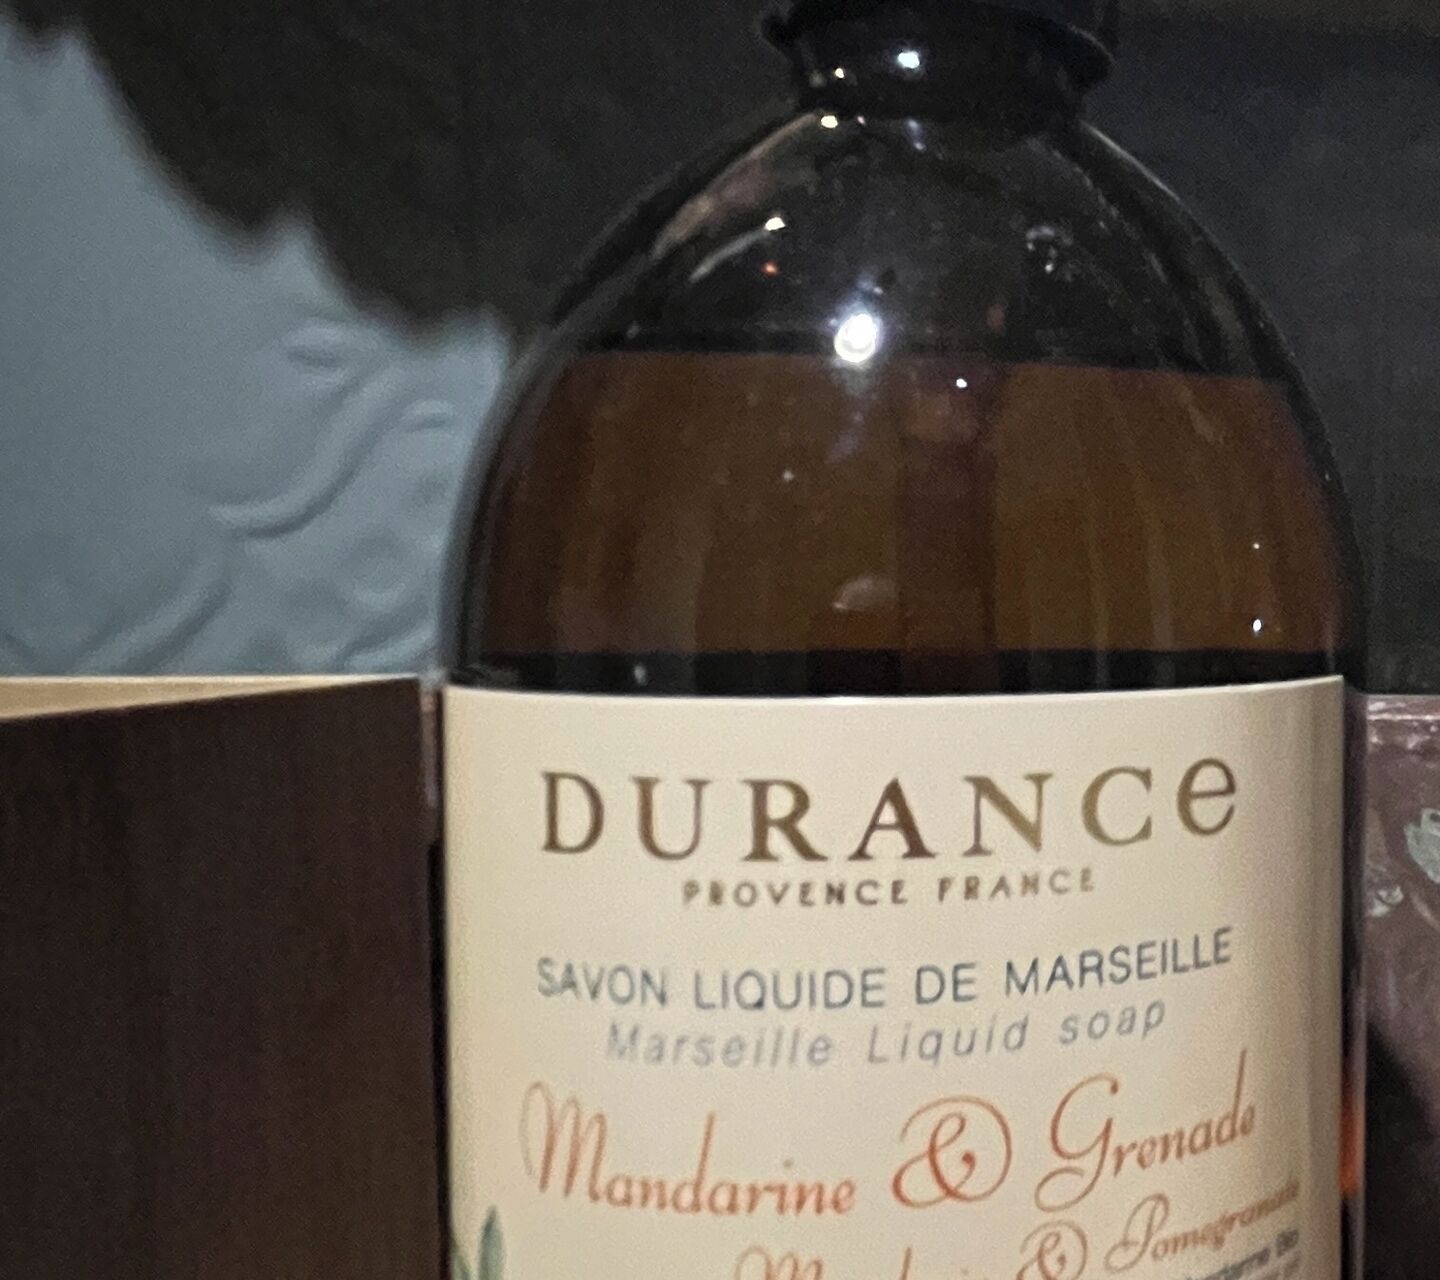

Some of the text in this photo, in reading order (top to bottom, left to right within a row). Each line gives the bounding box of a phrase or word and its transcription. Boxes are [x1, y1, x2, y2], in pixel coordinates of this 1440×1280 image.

[681, 866, 1097, 907] PROVENCE FRANCE
[536, 924, 1234, 1012] SAVON LIQUIDE DE MARSEILLE
[605, 998, 1166, 1068] Marseille Liquid soap
[518, 1048, 1256, 1217] Mandarine & Grenade
